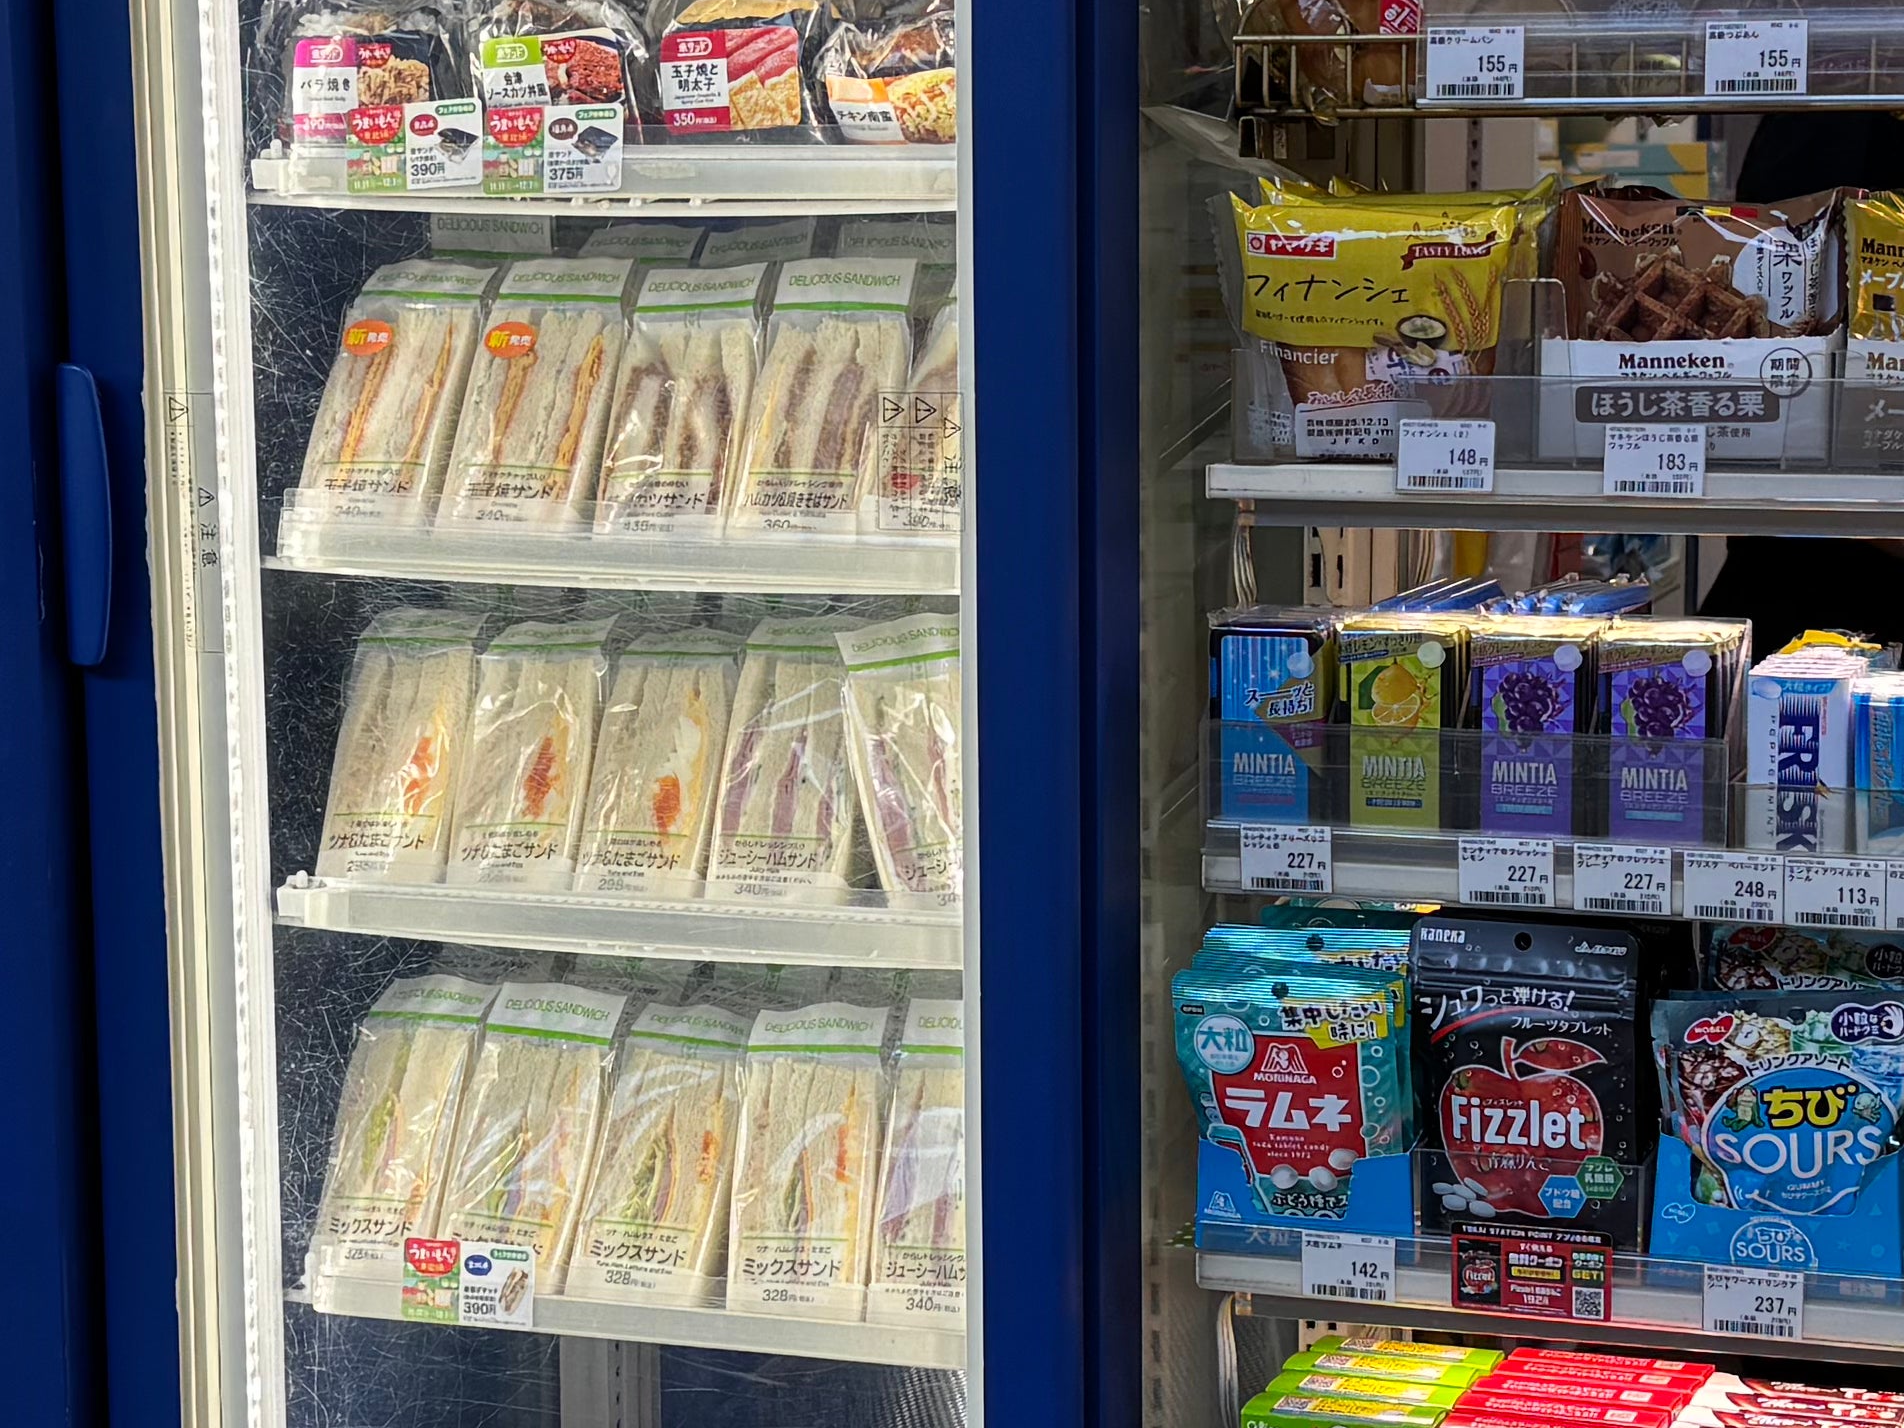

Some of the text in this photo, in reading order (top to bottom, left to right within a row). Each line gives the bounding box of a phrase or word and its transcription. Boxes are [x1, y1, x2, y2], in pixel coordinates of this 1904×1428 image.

[1477, 54, 1517, 72] 155円
[1758, 49, 1801, 68] 155円
[670, 63, 719, 79] 玉子焼と
[677, 77, 716, 92] 明太子
[1246, 273, 1411, 305] フィナンシェ
[1618, 351, 1726, 371] Manneken
[1591, 390, 1765, 418] ほうじ茶香る栗
[1656, 453, 1699, 472] 183円
[1492, 760, 1557, 786] MINTIA
[1287, 851, 1326, 871] 227円
[1734, 879, 1777, 900] 248円
[1199, 1024, 1250, 1053] 大粒
[1254, 1071, 1317, 1086] MORINAGA
[1223, 1086, 1351, 1134] ラムネ
[1762, 1085, 1857, 1129] ちび
[1452, 1097, 1585, 1152] Fizzlet
[1713, 1127, 1881, 1179] SOURS
[589, 1238, 688, 1267] ミックスサンド
[742, 1257, 843, 1278] ミックスサンド
[1755, 1296, 1796, 1315] 237円
